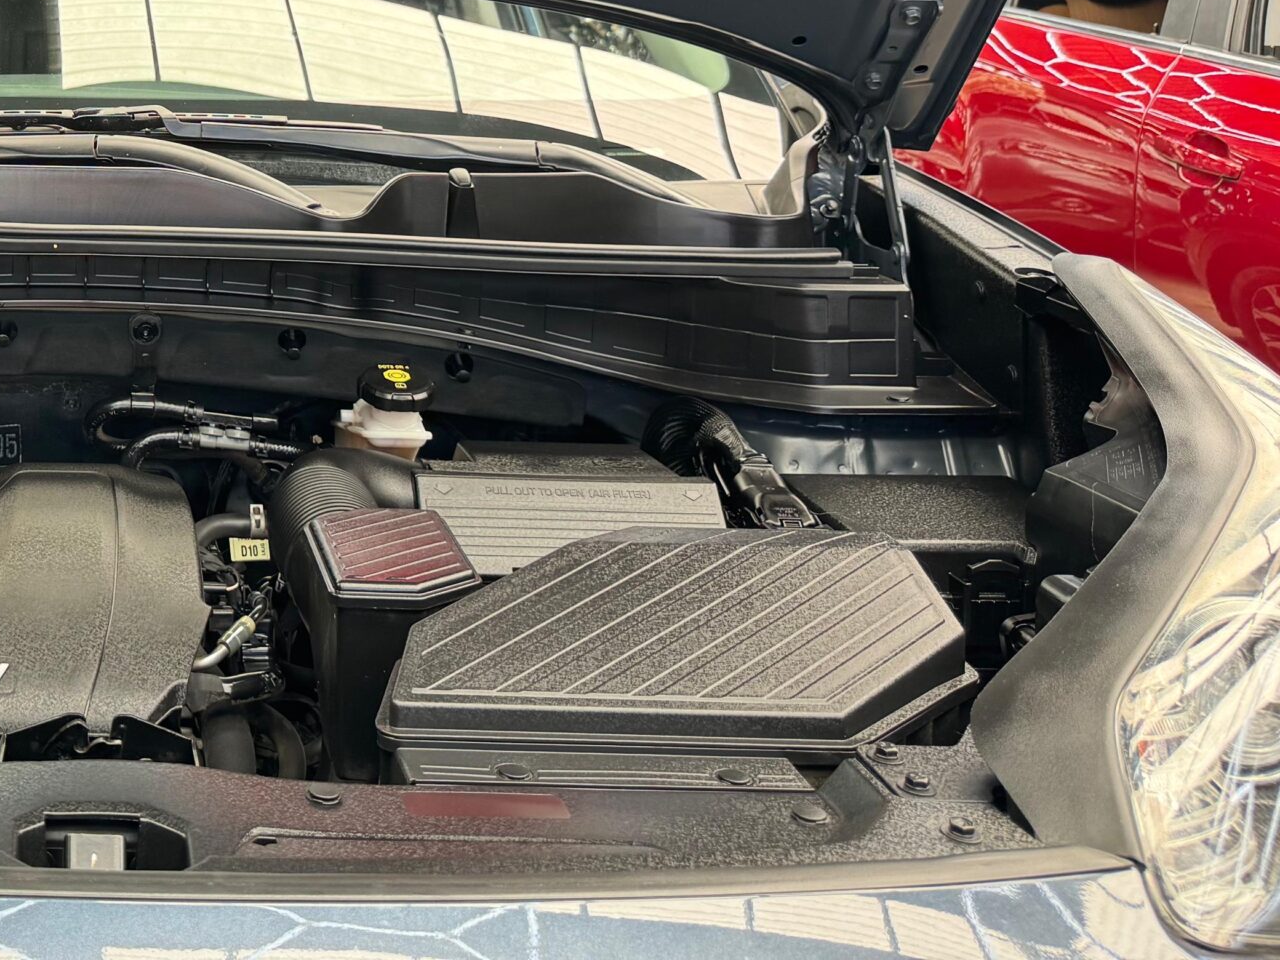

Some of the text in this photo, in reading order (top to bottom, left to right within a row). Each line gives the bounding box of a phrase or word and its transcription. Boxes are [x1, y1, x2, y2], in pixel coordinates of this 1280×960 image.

[485, 486, 512, 496] PULL
[514, 487, 536, 496] OUT
[540, 488, 553, 497] TO
[554, 488, 584, 498] OPEN
[241, 544, 259, 557] D10
